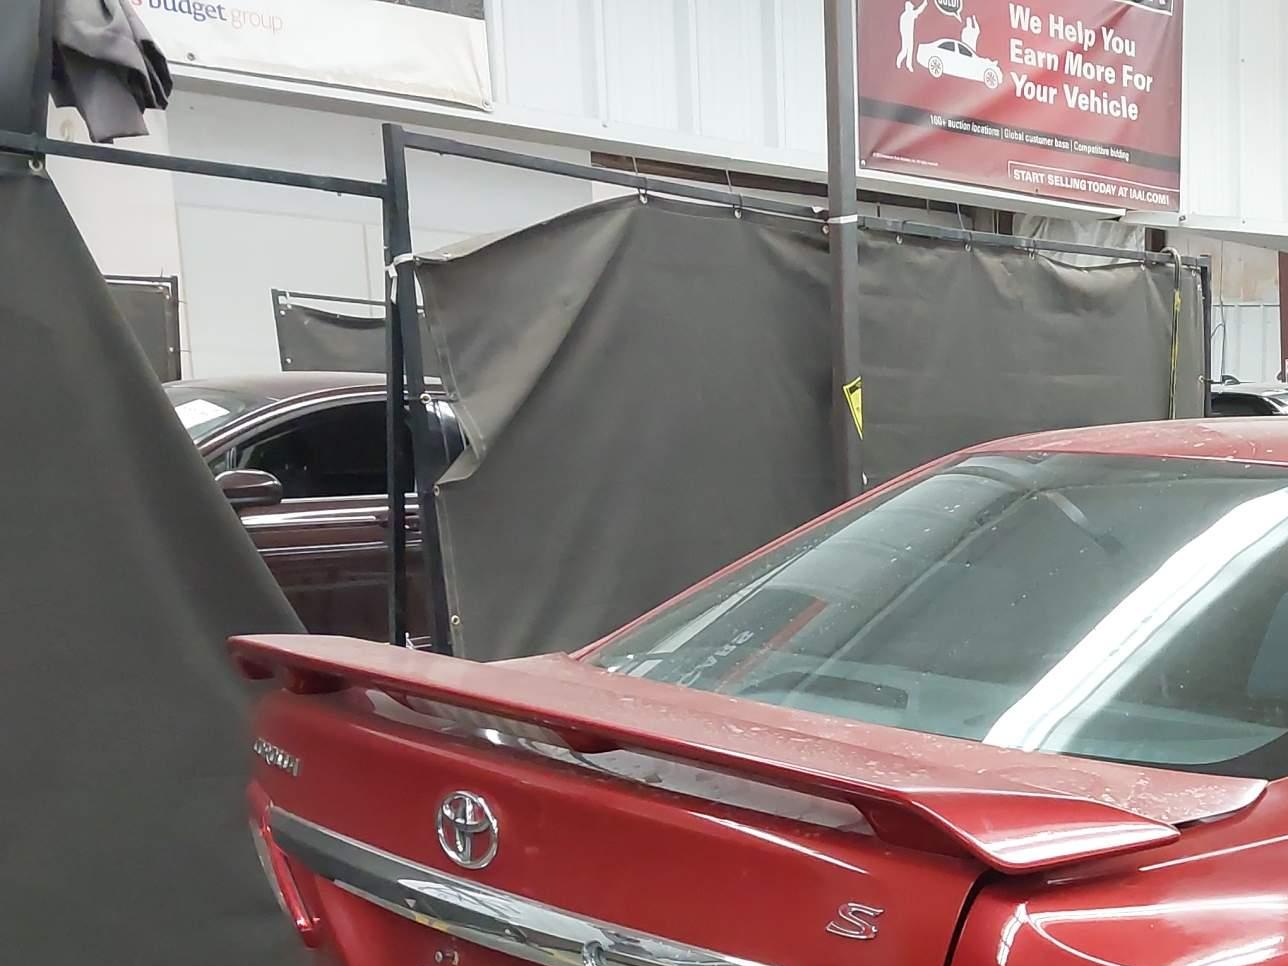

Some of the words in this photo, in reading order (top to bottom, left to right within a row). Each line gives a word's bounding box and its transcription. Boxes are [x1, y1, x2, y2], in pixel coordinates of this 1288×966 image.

[230, 8, 283, 32] group
[1008, 2, 1042, 35] We
[1049, 13, 1096, 51] Help
[1101, 26, 1136, 58] You
[1009, 38, 1059, 71] Earn
[1064, 50, 1116, 84] More
[1122, 64, 1153, 92] For
[1010, 71, 1058, 105] Your
[1063, 83, 1139, 121] Vehicle
[947, 119, 971, 131] auction
[971, 121, 1000, 137] locations
[1004, 127, 1025, 141] Global
[1025, 134, 1054, 146] customer
[1054, 137, 1070, 149] base
[1073, 140, 1110, 156] Competitive
[1110, 146, 1130, 162] bidding
[1013, 168, 1045, 184] START
[1047, 174, 1087, 191] SELLING
[1087, 180, 1117, 196] TODAY
[1117, 185, 1129, 198] AT
[1129, 187, 1169, 205] IAAI.COM!
[825, 902, 884, 940] S
